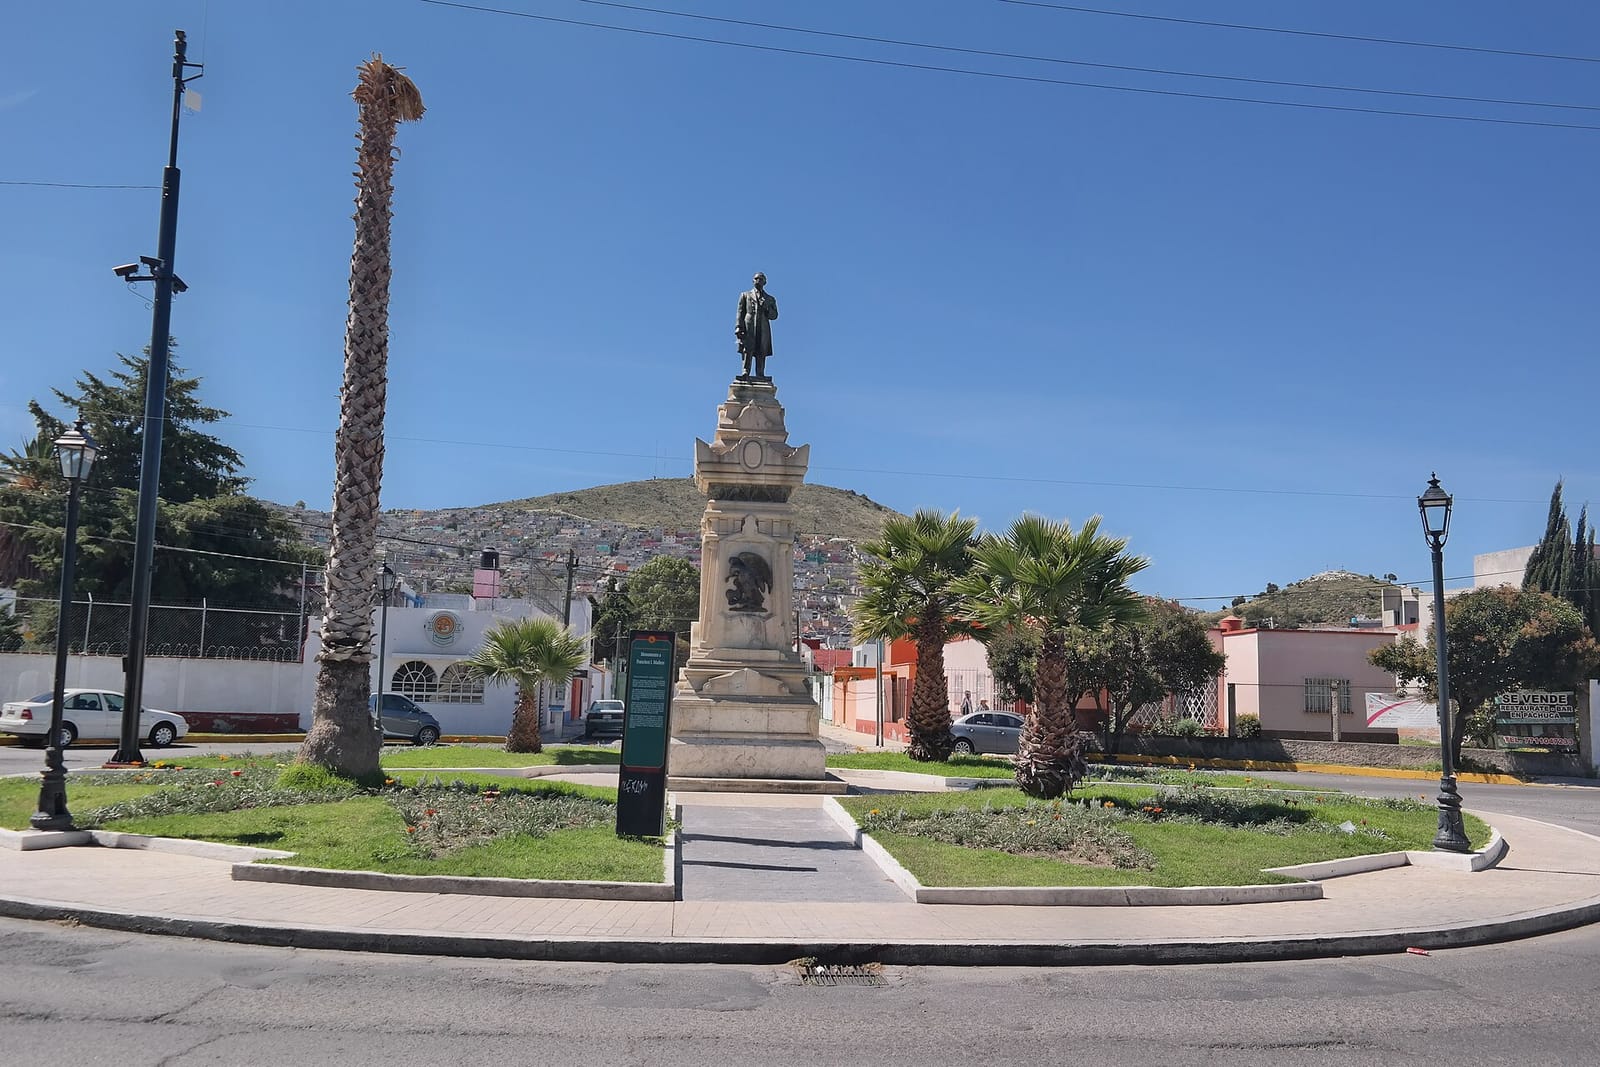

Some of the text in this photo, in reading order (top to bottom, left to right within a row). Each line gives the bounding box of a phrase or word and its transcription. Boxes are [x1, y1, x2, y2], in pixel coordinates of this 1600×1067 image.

[1502, 693, 1568, 705] SE VENDE
[1522, 711, 1561, 719] PACHUCA
